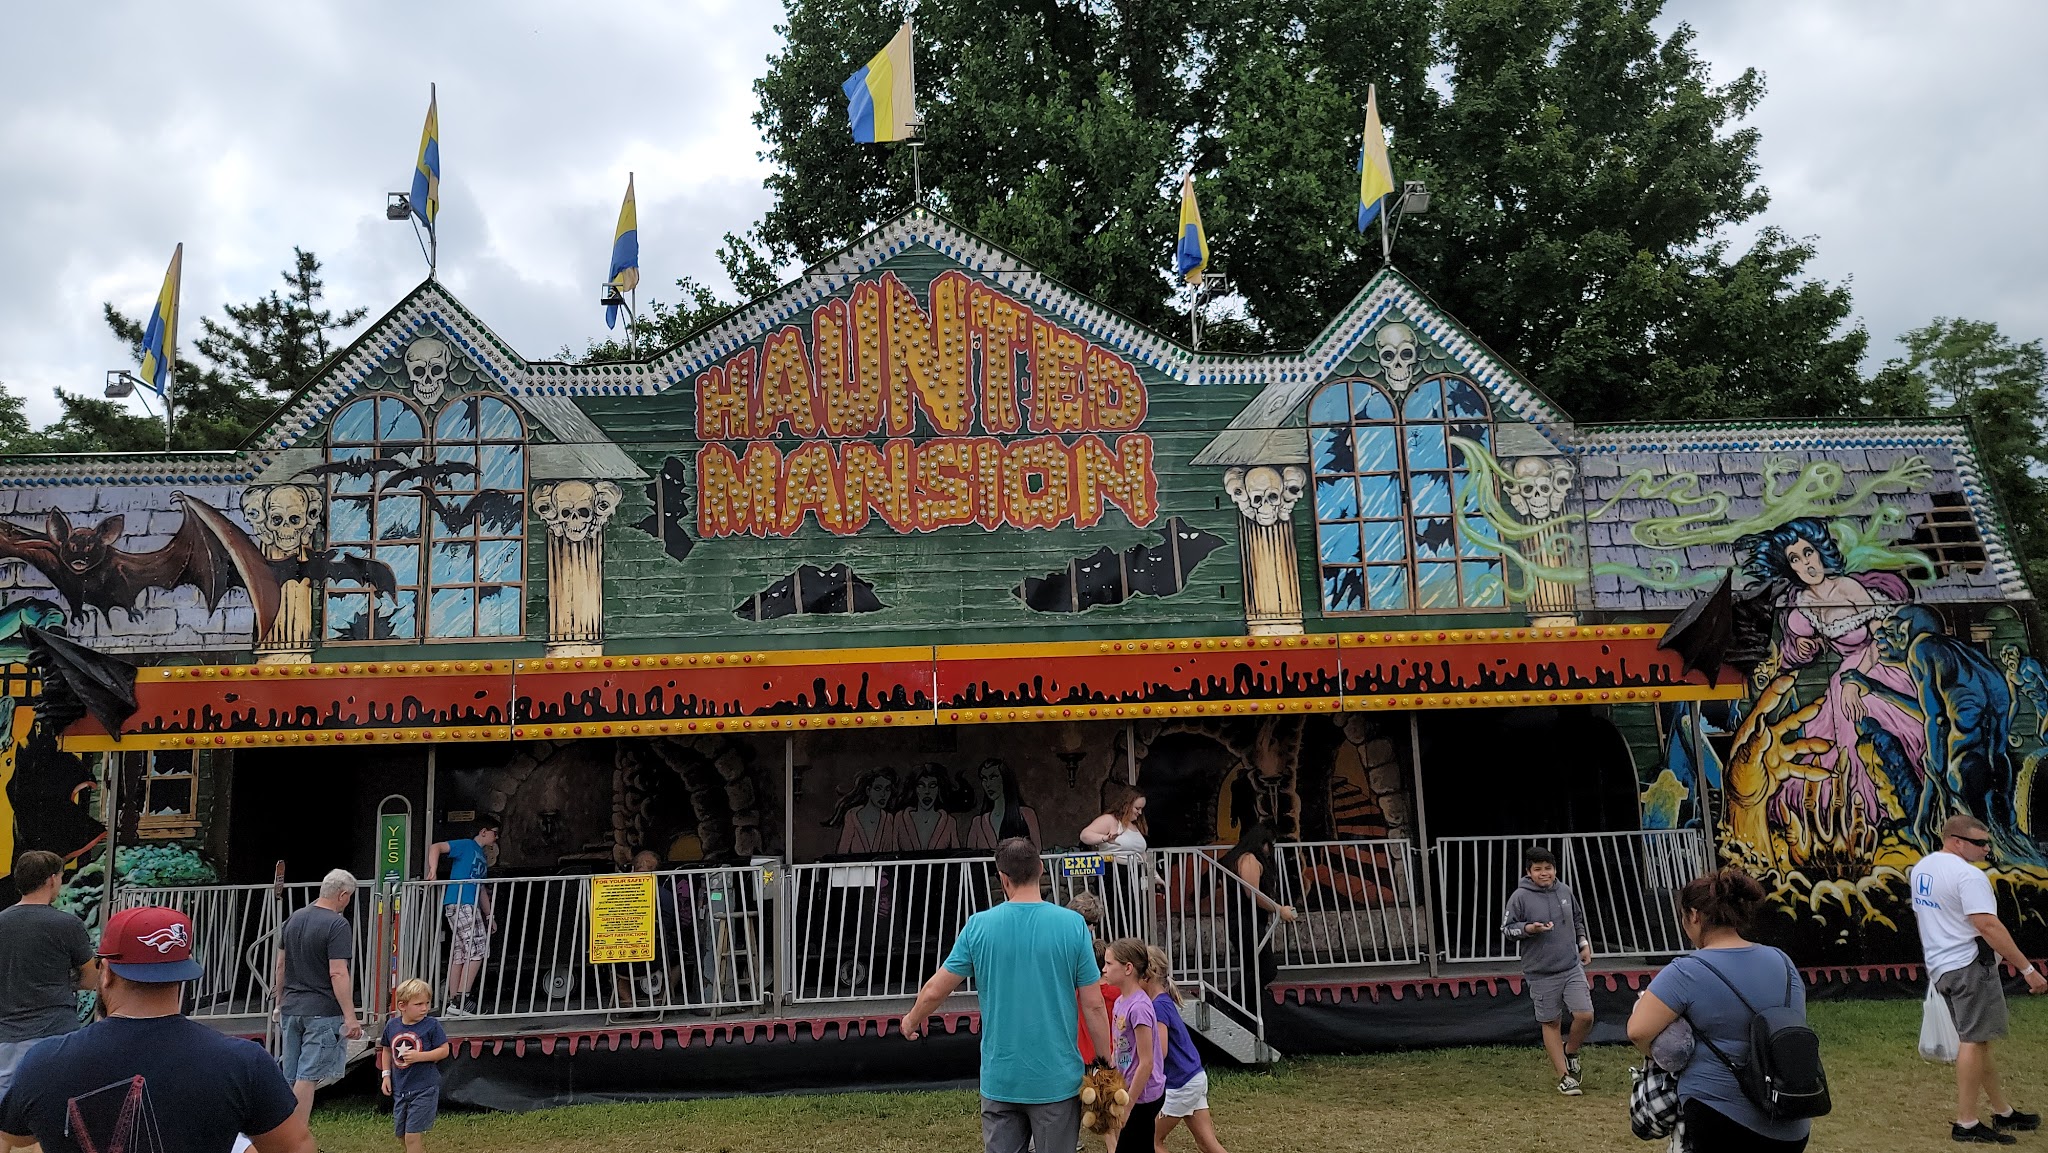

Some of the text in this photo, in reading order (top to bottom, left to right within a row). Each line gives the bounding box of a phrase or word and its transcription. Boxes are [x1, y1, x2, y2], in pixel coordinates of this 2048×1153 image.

[695, 270, 1148, 438] HAUNTED
[696, 433, 1160, 538] MANSION
[387, 825, 400, 863] YES
[1064, 856, 1102, 869] EXIT
